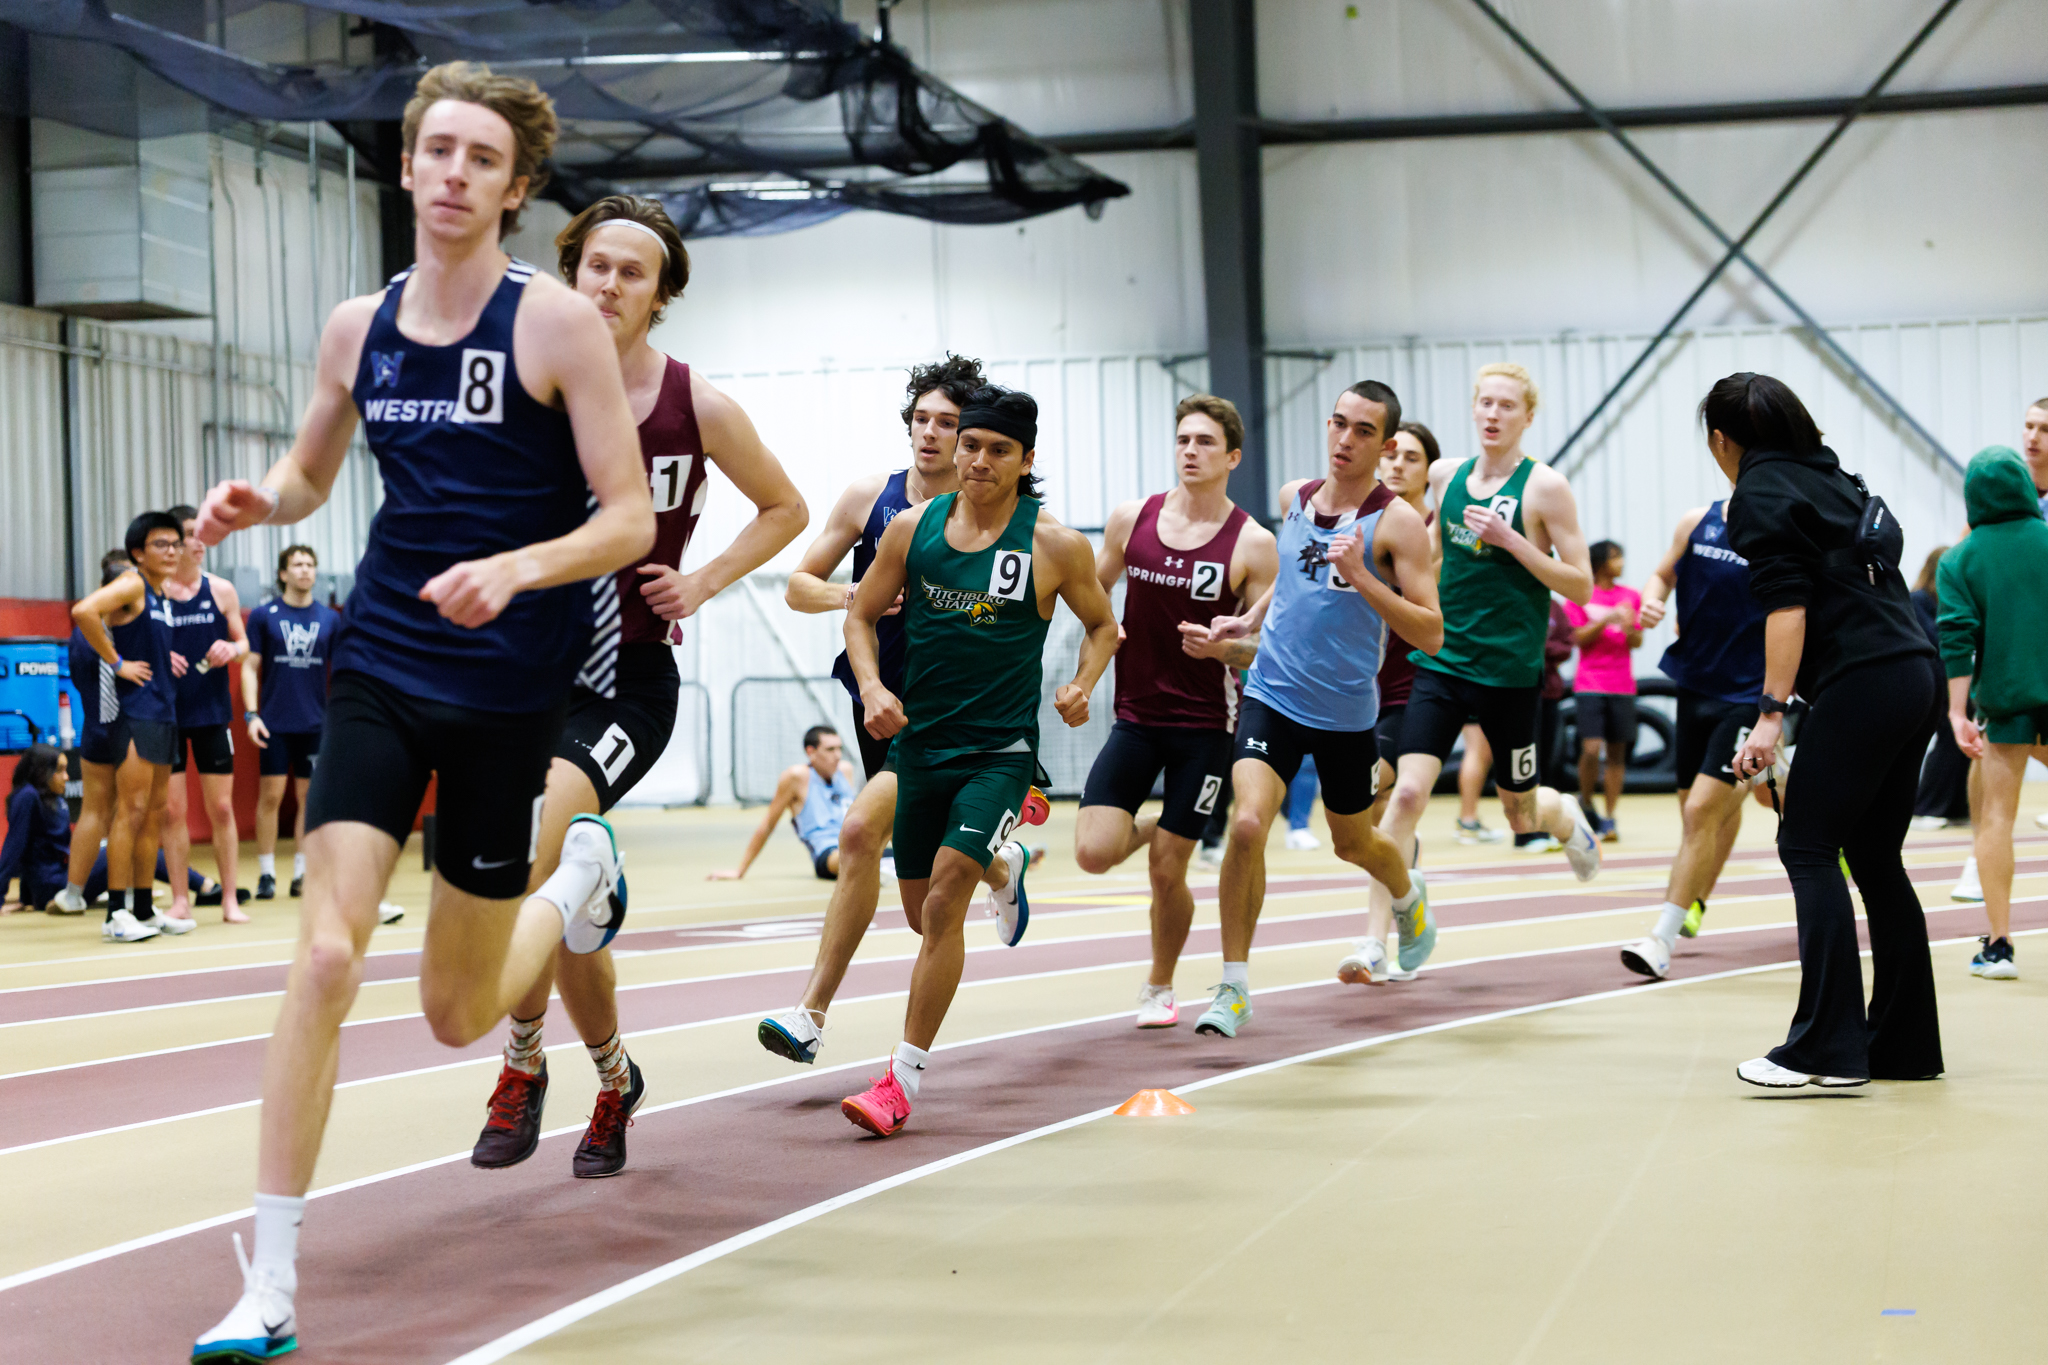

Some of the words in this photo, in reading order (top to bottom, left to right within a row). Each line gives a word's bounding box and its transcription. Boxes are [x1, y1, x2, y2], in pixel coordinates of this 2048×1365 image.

[465, 356, 494, 415] 8
[660, 460, 679, 507] 1
[997, 553, 1022, 596] 9
[1195, 565, 1218, 598] 2
[924, 582, 1005, 605] FITCHBURG
[933, 598, 977, 611] STATE
[603, 734, 628, 771] 1
[1519, 749, 1532, 777] 6
[1199, 779, 1218, 811] 2
[993, 816, 1015, 854] 9
